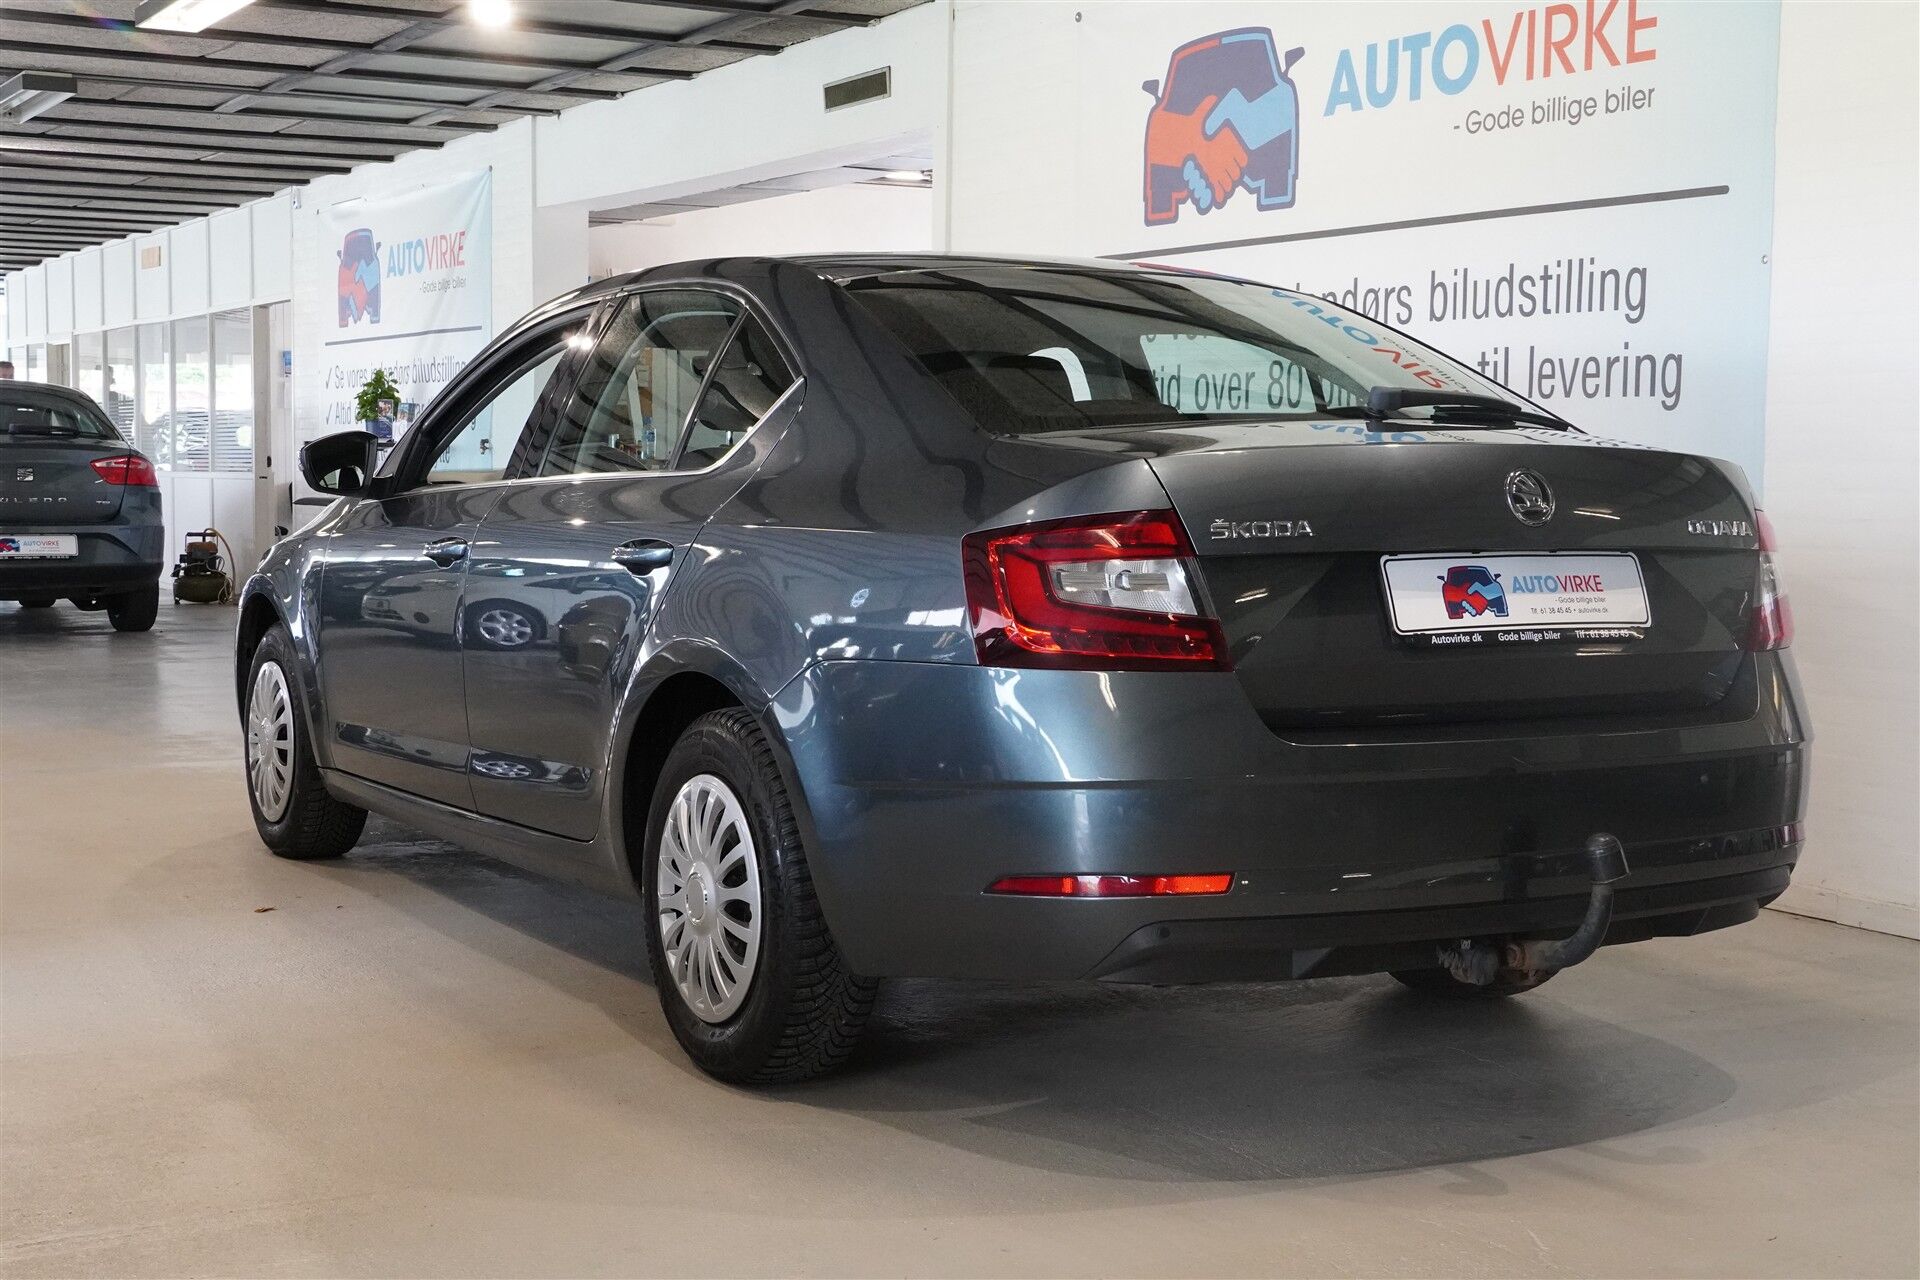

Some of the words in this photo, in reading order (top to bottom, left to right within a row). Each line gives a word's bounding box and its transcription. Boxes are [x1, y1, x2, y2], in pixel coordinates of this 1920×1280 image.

[1323, 0, 1658, 117] AUTOVIRKE
[1465, 104, 1525, 135] Gode
[1531, 95, 1598, 126] billige
[1604, 86, 1655, 114] biler
[386, 230, 466, 278] AUTOVIRKE
[1428, 257, 1648, 325] biludstilling
[334, 364, 345, 389] Se
[1194, 368, 1256, 412] over
[1267, 359, 1303, 410] 80
[1527, 341, 1683, 411] levering
[1210, 518, 1314, 540] ŠKODA
[1687, 519, 1754, 536] OCTAVIA
[22, 540, 60, 548] AUTOVIRKE
[1511, 574, 1604, 594] AUTOVIRKE
[1540, 607, 1547, 615] 61
[1558, 596, 1575, 604] Gode
[1576, 596, 1593, 605] billige
[1594, 596, 1606, 604] biler
[1498, 632, 1519, 641] Gode
[1520, 631, 1543, 642] billige
[1544, 630, 1561, 640] biler
